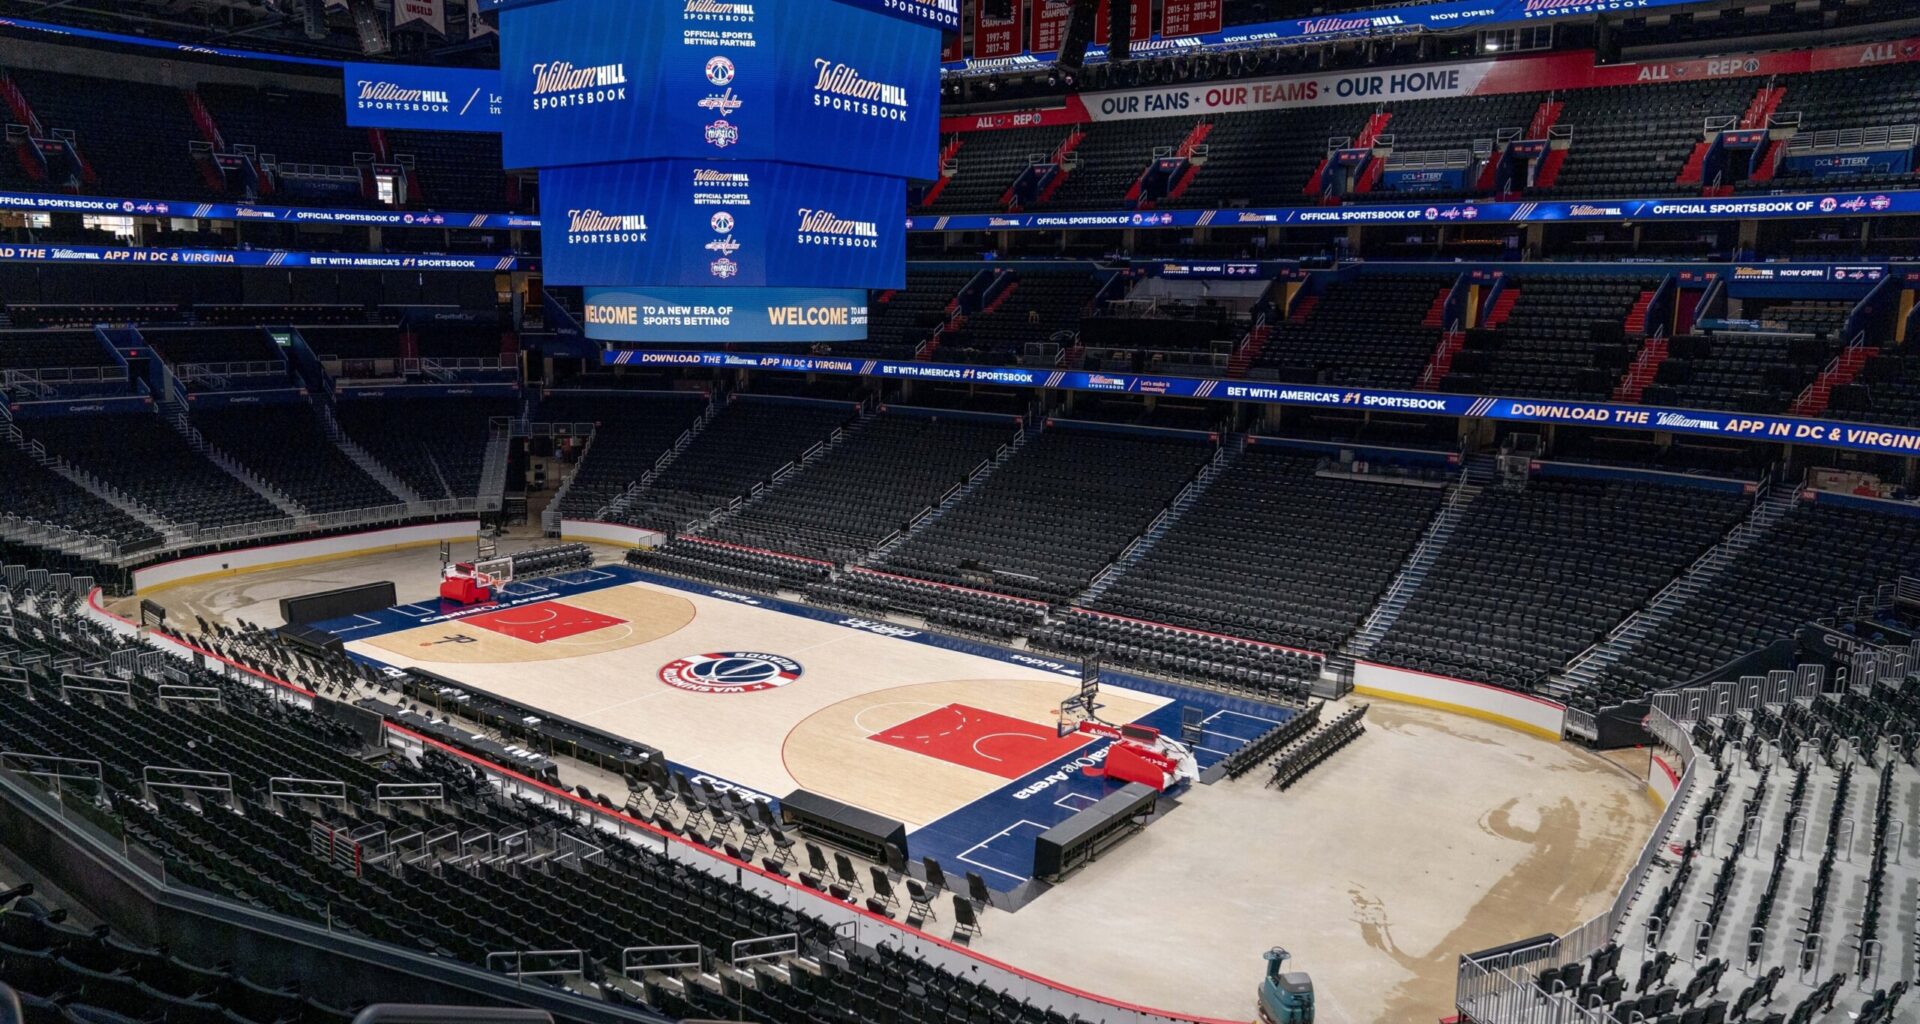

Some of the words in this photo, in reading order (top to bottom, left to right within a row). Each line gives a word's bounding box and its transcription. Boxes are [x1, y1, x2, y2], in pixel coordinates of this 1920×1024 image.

[406, 4, 432, 16] UNSELD
[733, 4, 754, 14] HILL
[885, 0, 958, 26] SPORTSBOOK
[1430, 12, 1460, 21] NOW
[1463, 9, 1494, 18] OPEN
[1525, 0, 1648, 18] SPORTSBOOK
[684, 13, 754, 22] SPORTSBOOK
[1167, 14, 1189, 24] 2016-17
[1166, 24, 1189, 34] 2017-18
[1297, 18, 1372, 35] William
[1372, 15, 1403, 26] HILL
[684, 38, 718, 46] BETTING
[720, 39, 756, 47] PARTNER
[986, 32, 1010, 42] 1997-98
[1175, 37, 1202, 47] HILL
[986, 43, 1010, 53] 2017-18
[1860, 45, 1896, 63] ALL
[1013, 55, 1038, 64] HILL
[1638, 65, 1669, 80] ALL
[1708, 60, 1742, 75] REP
[532, 61, 596, 95] William
[597, 63, 626, 86] HILL
[815, 58, 882, 100] William
[881, 84, 907, 106] HILL
[358, 80, 421, 101] William
[422, 90, 448, 103] HILL
[1101, 98, 1140, 114] OUR
[1144, 92, 1189, 111] FANS
[1206, 86, 1247, 107] OUR
[1252, 81, 1318, 104] TEAMS
[1336, 76, 1383, 97] OUR
[1390, 70, 1459, 93] HOME
[534, 88, 625, 110] SPORTSBOOK
[358, 101, 448, 112] SPORTSBOOK
[814, 94, 906, 122] SPORTSBOOK
[976, 117, 994, 128] ALL
[1013, 115, 1034, 125] REP
[694, 169, 733, 181] William
[0, 197, 36, 206] FFICIAL
[38, 199, 104, 209] SPORTSBOOK
[1653, 204, 1707, 214] OFFICIAL
[1709, 202, 1793, 213] SPORTSBOOK
[1796, 201, 1814, 212] OF
[235, 208, 264, 217] William
[1300, 212, 1340, 220] OFFICIAL
[1342, 210, 1404, 220] SPORTSBOOK
[1407, 210, 1421, 218] OF
[1569, 204, 1606, 216] William
[297, 212, 333, 221] OFFICIAL
[335, 214, 387, 222] SPORTSBOOK
[568, 208, 622, 233] William
[622, 215, 647, 230] HILL
[798, 208, 855, 235] William
[854, 222, 878, 237] HILL
[1069, 217, 1117, 225] SPORTSBOOK
[1238, 212, 1266, 222] William
[568, 233, 647, 244] SPORTSBOOK
[798, 235, 878, 248] SPORTSBOOK
[19, 249, 45, 258] THE
[51, 248, 85, 259] William
[104, 251, 130, 260] APP
[133, 252, 146, 261] IN
[150, 252, 167, 261] DC
[171, 253, 179, 262] &
[182, 253, 234, 263] VIRGINIA
[354, 258, 400, 266] AMERICA'S
[402, 258, 415, 266] #1
[585, 305, 637, 325] WELCOME
[643, 306, 655, 314] TO
[657, 306, 666, 314] A
[668, 306, 691, 314] NEW
[695, 306, 717, 315] ERA
[719, 306, 733, 315] OF
[768, 307, 848, 325] WELCOME
[643, 316, 682, 326] SPORTS
[684, 316, 729, 325] BETTING
[642, 354, 700, 363] DOWNLOAD
[704, 355, 721, 364] THE
[760, 358, 780, 366] APP
[782, 358, 792, 367] IN
[794, 359, 806, 368] DC
[807, 360, 813, 368] &
[815, 360, 852, 370] VIRGINIA
[883, 365, 897, 374] BET
[898, 366, 918, 375] WITH
[919, 368, 961, 378] AMERICA'S
[963, 369, 974, 378] #1
[976, 371, 1032, 382] SPORTSBOOK
[1227, 386, 1247, 396] BET
[1250, 387, 1277, 398] WITH
[1280, 389, 1339, 402] AMERICA'S
[1342, 393, 1361, 405] #1
[1364, 395, 1446, 410] SPORTSBOOK
[1511, 403, 1609, 422] DOWNLOAD
[1615, 410, 1650, 424] THE
[1656, 411, 1700, 428] William
[1700, 420, 1719, 430] HILL
[1725, 419, 1764, 434] APP
[1768, 422, 1790, 436] IN
[1796, 424, 1823, 440] DC
[1828, 427, 1840, 442] &
[734, 652, 799, 671] WIZARDS
[1013, 770, 1068, 800] Arena
